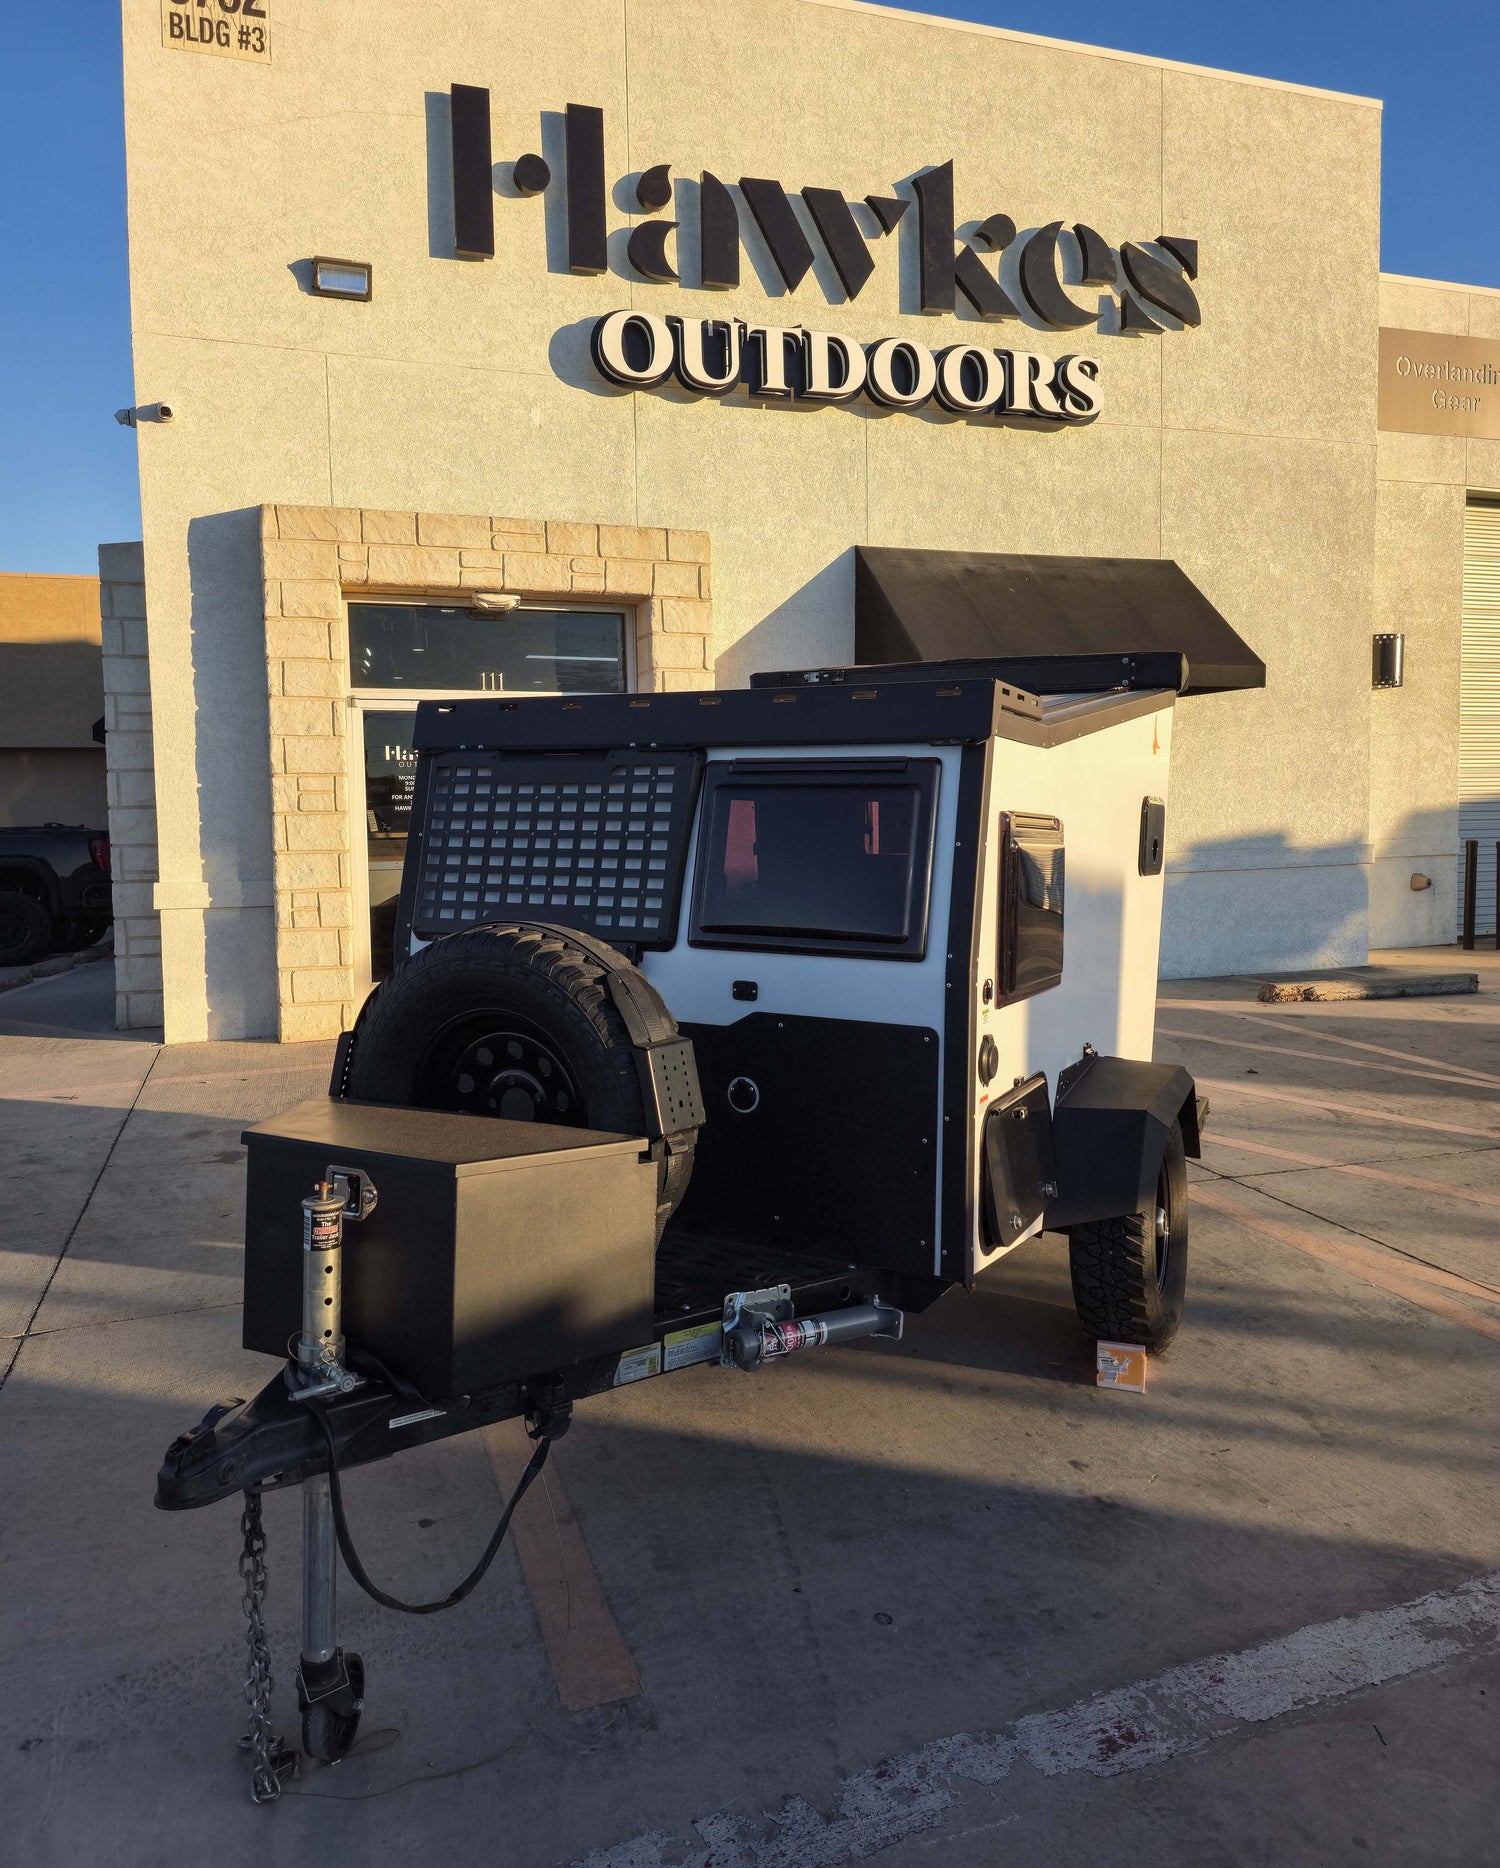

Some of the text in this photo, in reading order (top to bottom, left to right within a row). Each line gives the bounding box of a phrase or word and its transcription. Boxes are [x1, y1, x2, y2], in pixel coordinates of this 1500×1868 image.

[169, 12, 265, 53] BLDG #3
[450, 82, 1202, 338] Hawkes
[592, 309, 1105, 421] OUTDOORS
[1432, 388, 1481, 412] Gear
[480, 671, 504, 691] 111
